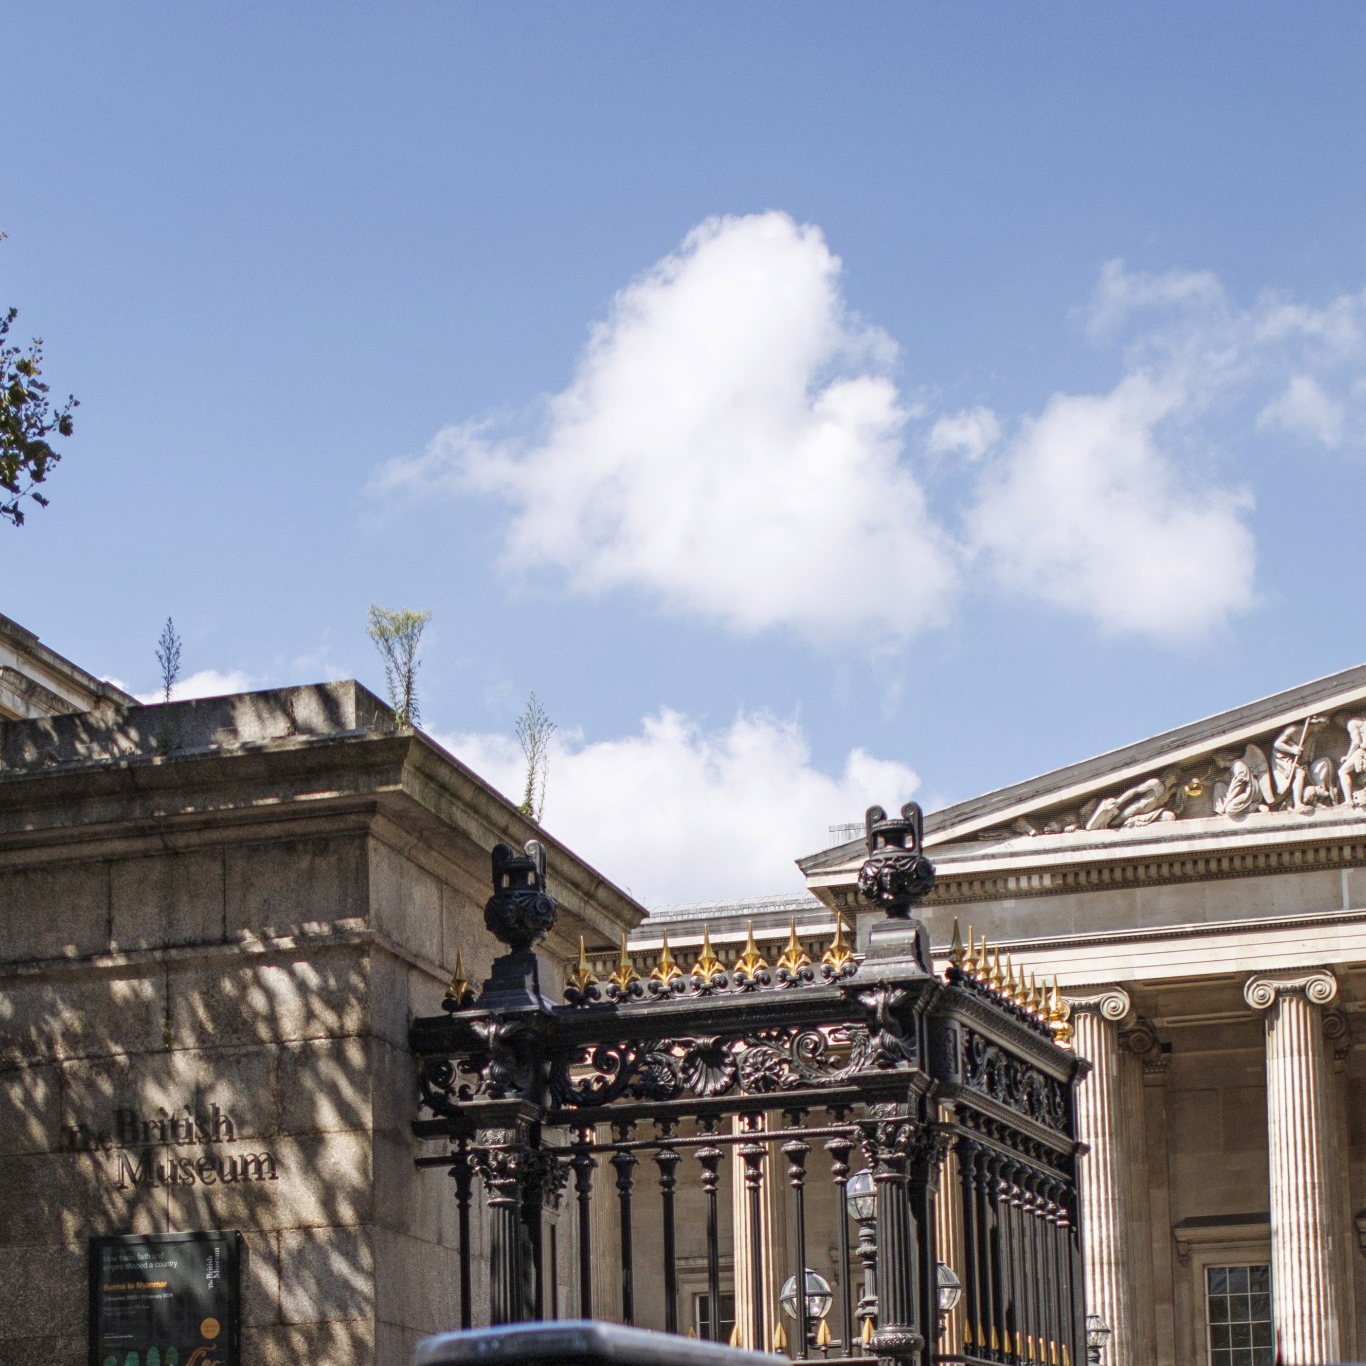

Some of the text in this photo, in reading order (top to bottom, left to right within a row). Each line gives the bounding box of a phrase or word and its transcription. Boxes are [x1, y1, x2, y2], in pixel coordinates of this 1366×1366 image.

[68, 1102, 237, 1151] The British
[117, 1151, 279, 1189] Museum
[155, 1260, 178, 1269] country
